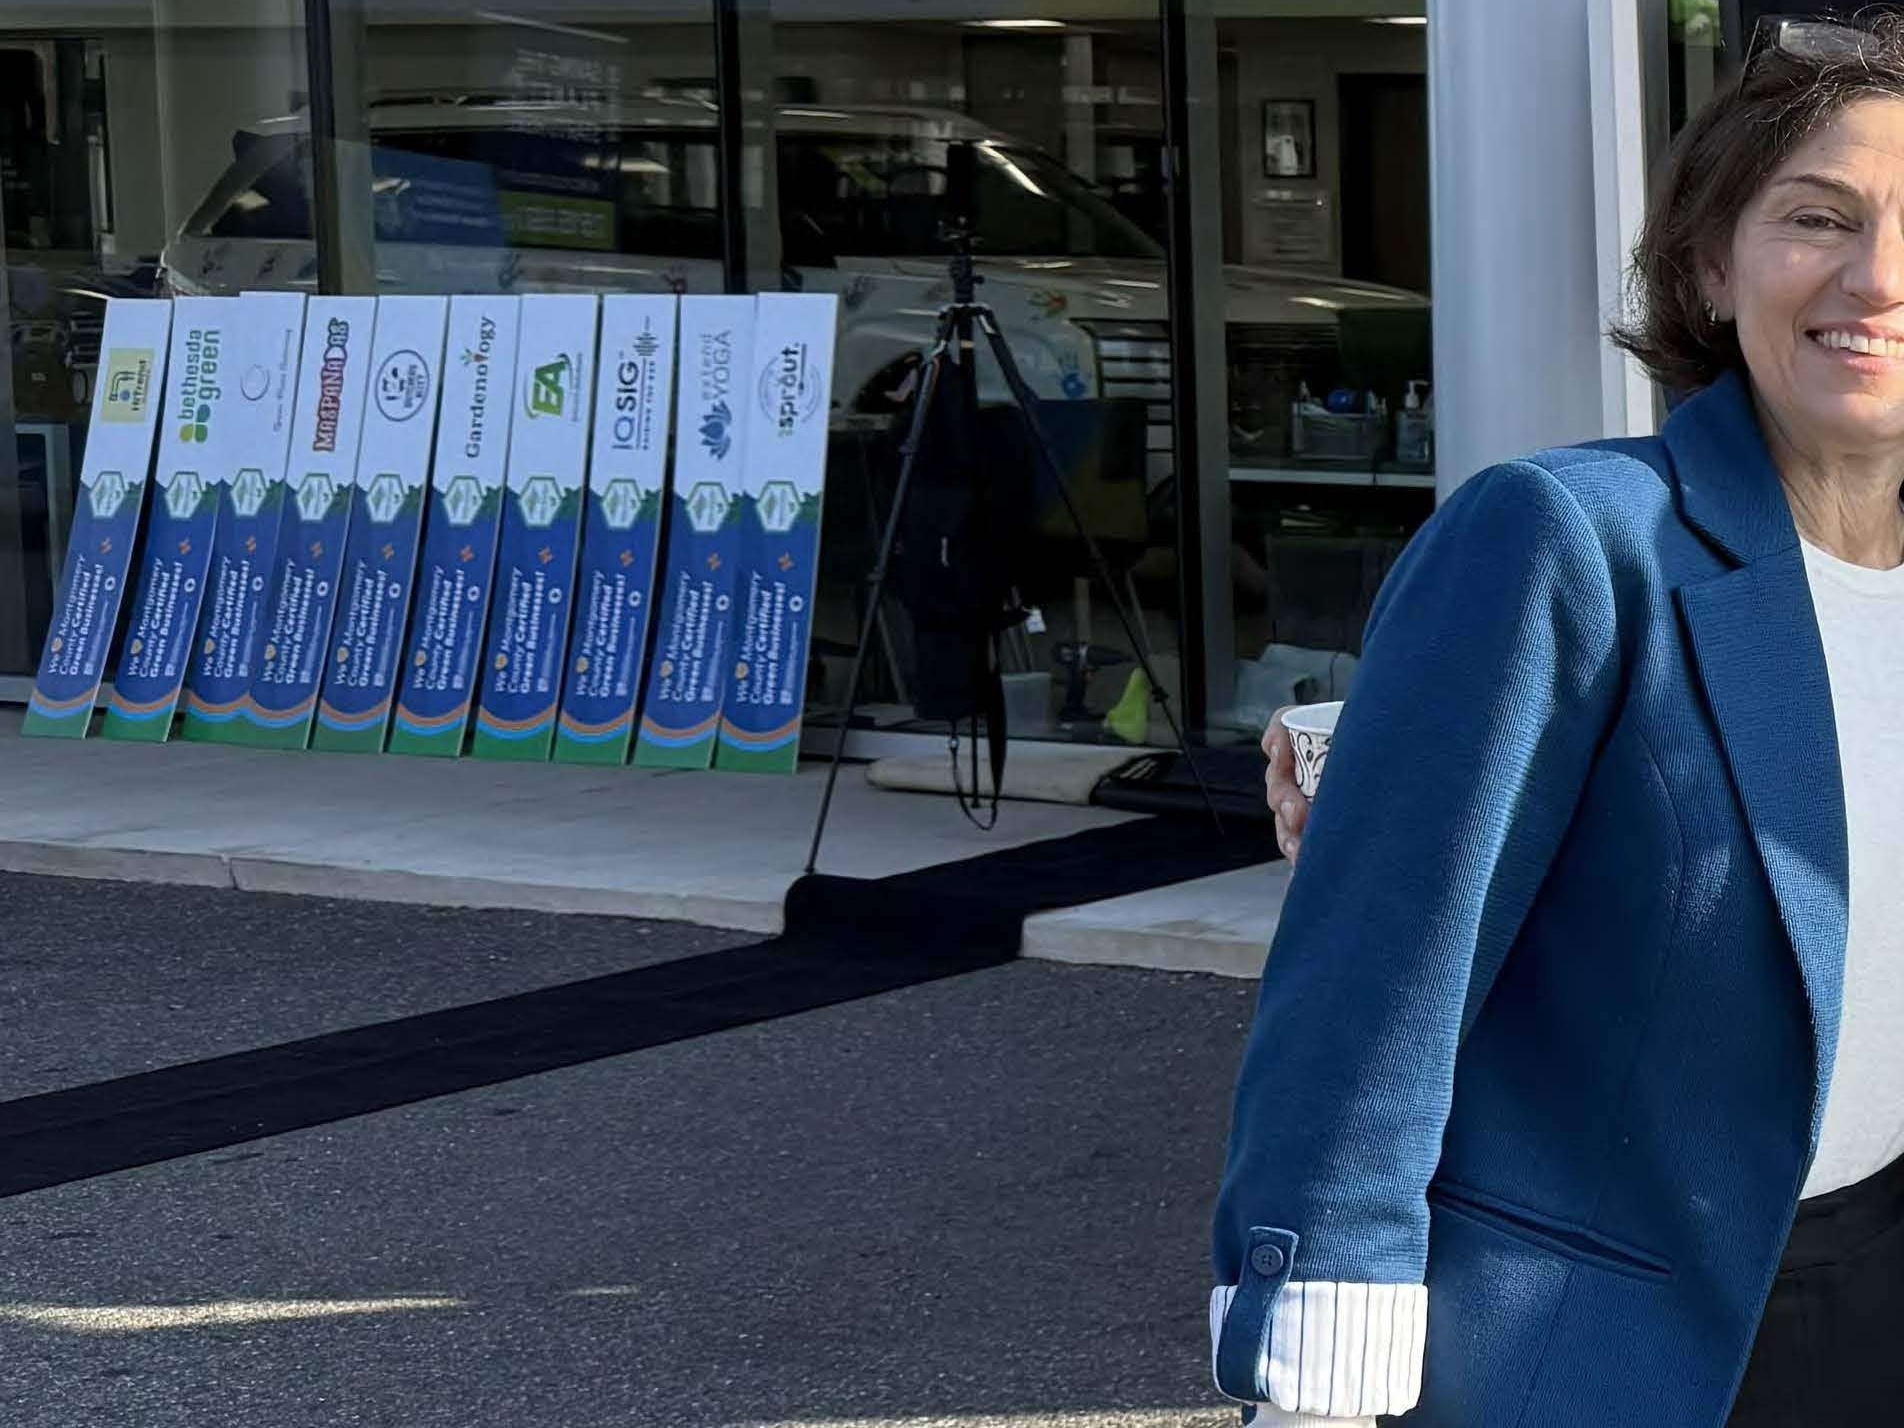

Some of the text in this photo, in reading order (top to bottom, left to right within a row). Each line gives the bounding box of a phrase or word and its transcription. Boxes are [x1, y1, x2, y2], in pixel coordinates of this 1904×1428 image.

[178, 328, 204, 421] bethesda
[197, 328, 227, 401] green
[712, 329, 733, 400] YOGA
[58, 571, 93, 676] County Certified
[69, 637, 87, 676] Green
[138, 571, 172, 678] County Certified
[148, 637, 167, 678] Green
[213, 570, 239, 678] County Certified
[223, 638, 238, 678] Green
[274, 576, 303, 684] County Certified
[347, 578, 375, 687] County Certified
[426, 580, 452, 690] County Certified
[507, 582, 532, 693] County Certified
[588, 585, 613, 697] County Certified
[672, 589, 700, 702] County Certified
[748, 591, 773, 704] County Certified
[285, 643, 301, 685] Green
[359, 646, 375, 687] Green
[437, 649, 452, 691] Green
[520, 652, 535, 694] Green
[600, 655, 616, 697] Green
[686, 660, 702, 702] Green
[762, 661, 778, 704] Green
